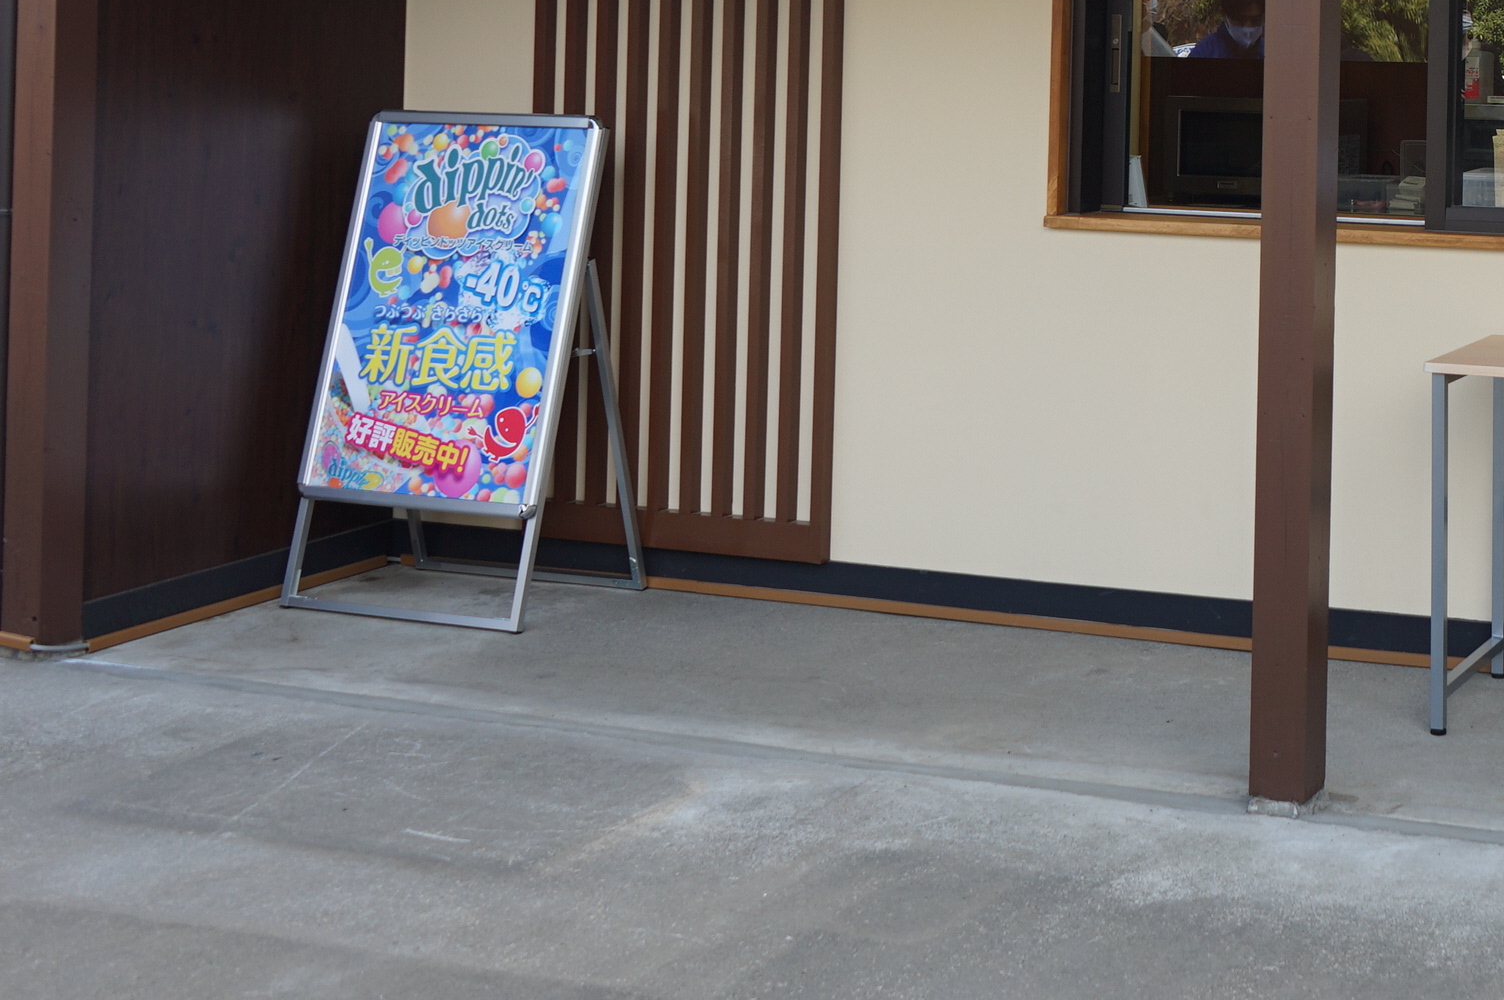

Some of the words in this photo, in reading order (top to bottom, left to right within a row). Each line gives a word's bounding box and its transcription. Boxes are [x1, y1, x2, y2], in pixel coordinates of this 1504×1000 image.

[414, 144, 535, 214] dippin'
[467, 202, 515, 230] dots
[431, 305, 482, 323] さらさら
[359, 323, 518, 391] 新食感
[378, 391, 484, 418] アイスクリーム
[347, 414, 470, 473] 好評販売中!
